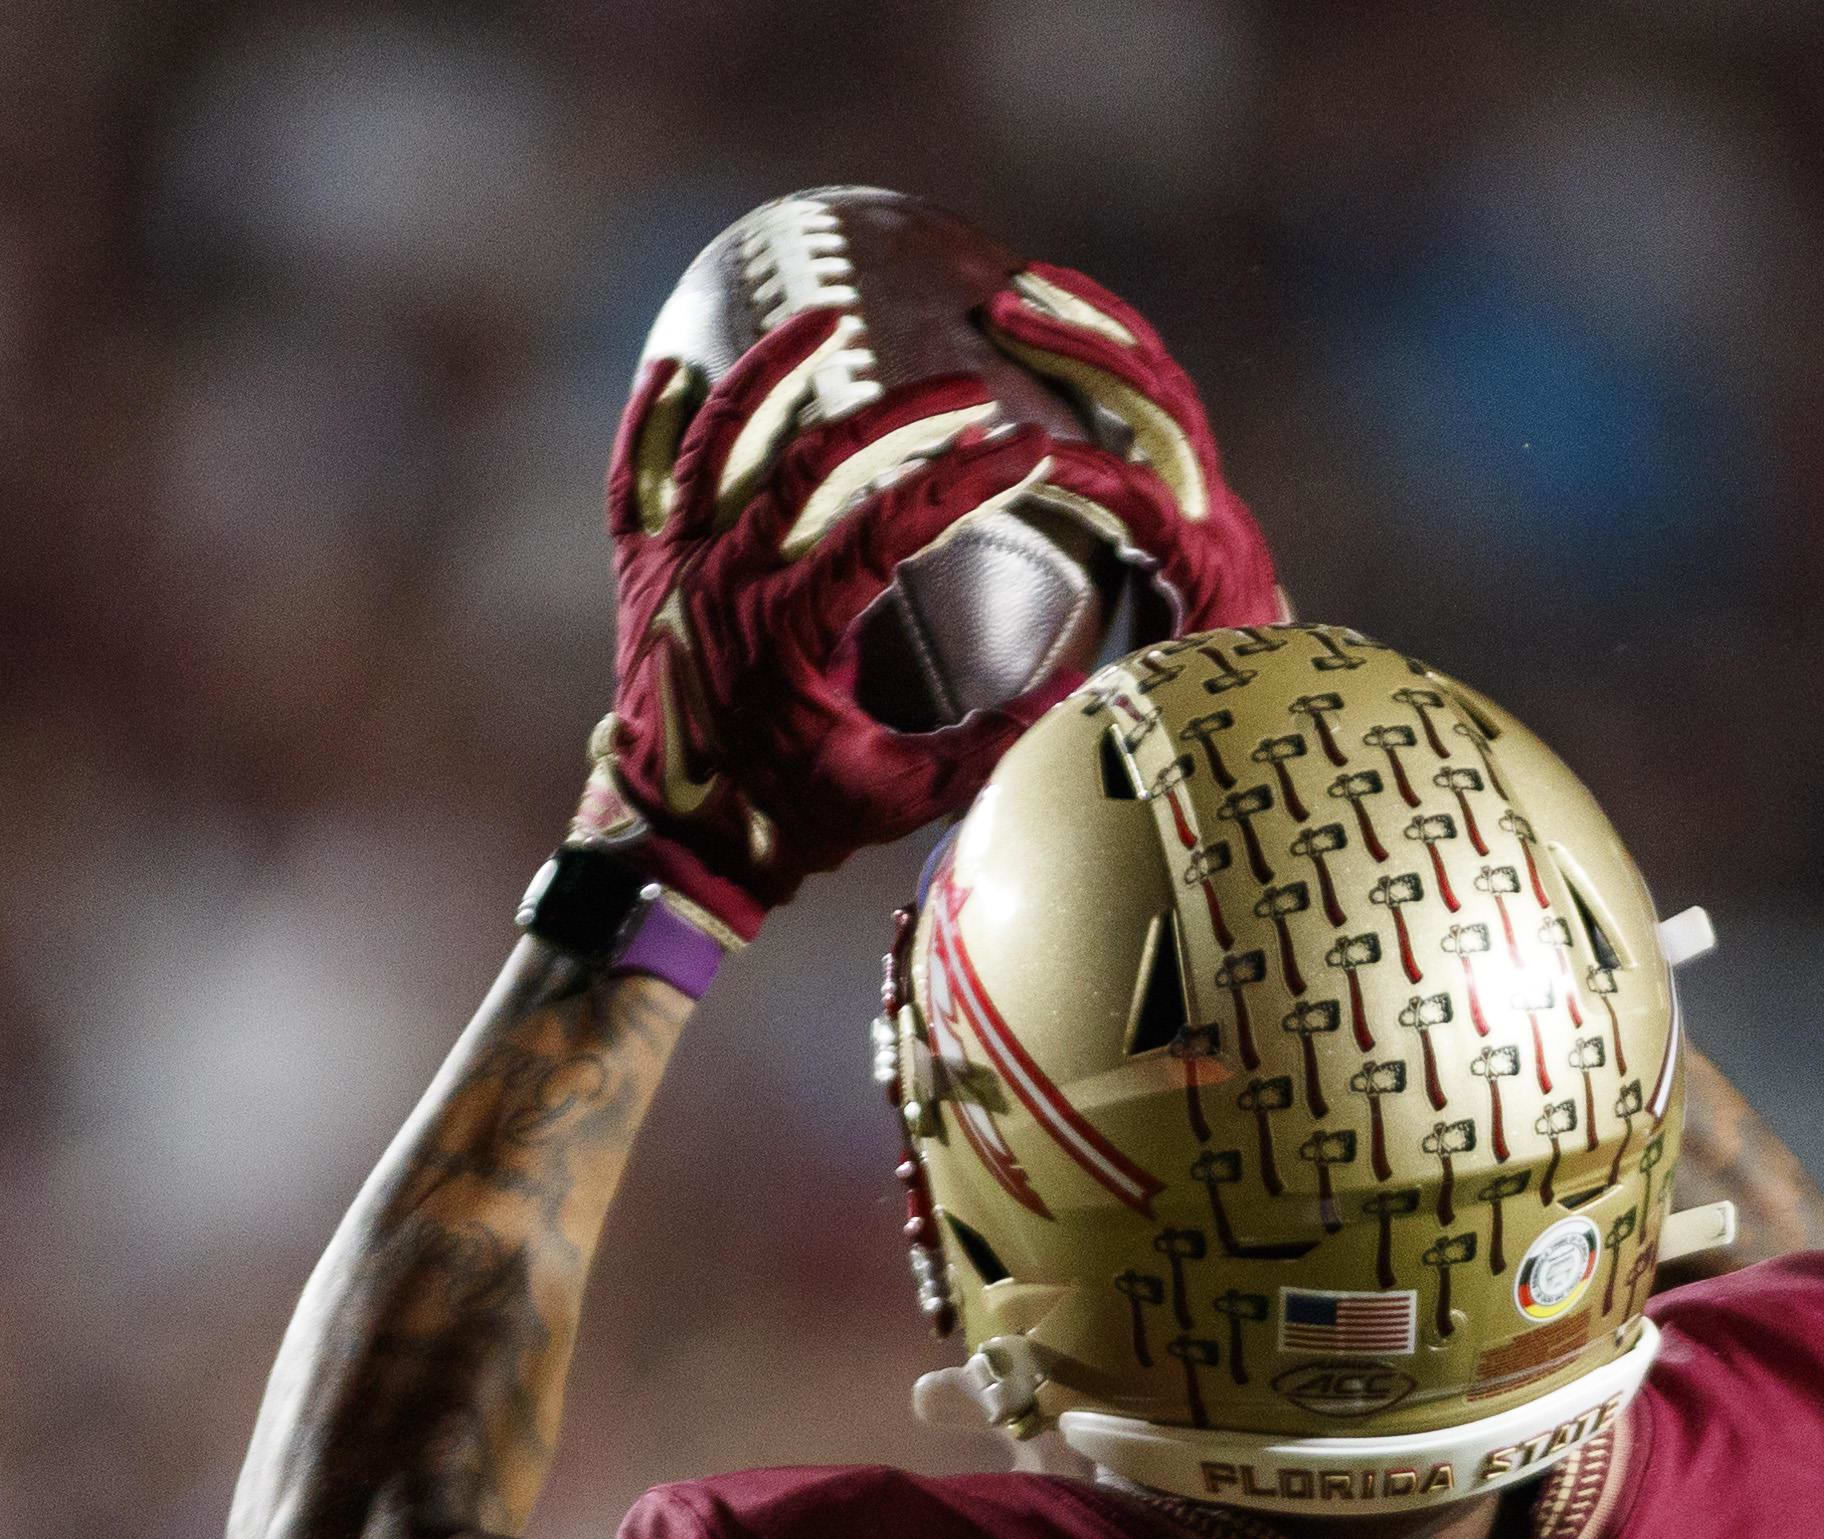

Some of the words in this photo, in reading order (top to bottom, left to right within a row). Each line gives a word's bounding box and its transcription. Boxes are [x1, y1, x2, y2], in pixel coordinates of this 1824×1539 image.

[1288, 1372, 1398, 1399] ACC
[1199, 1461, 1456, 1500] FLORIDA
[1479, 1391, 1623, 1482] STATE
